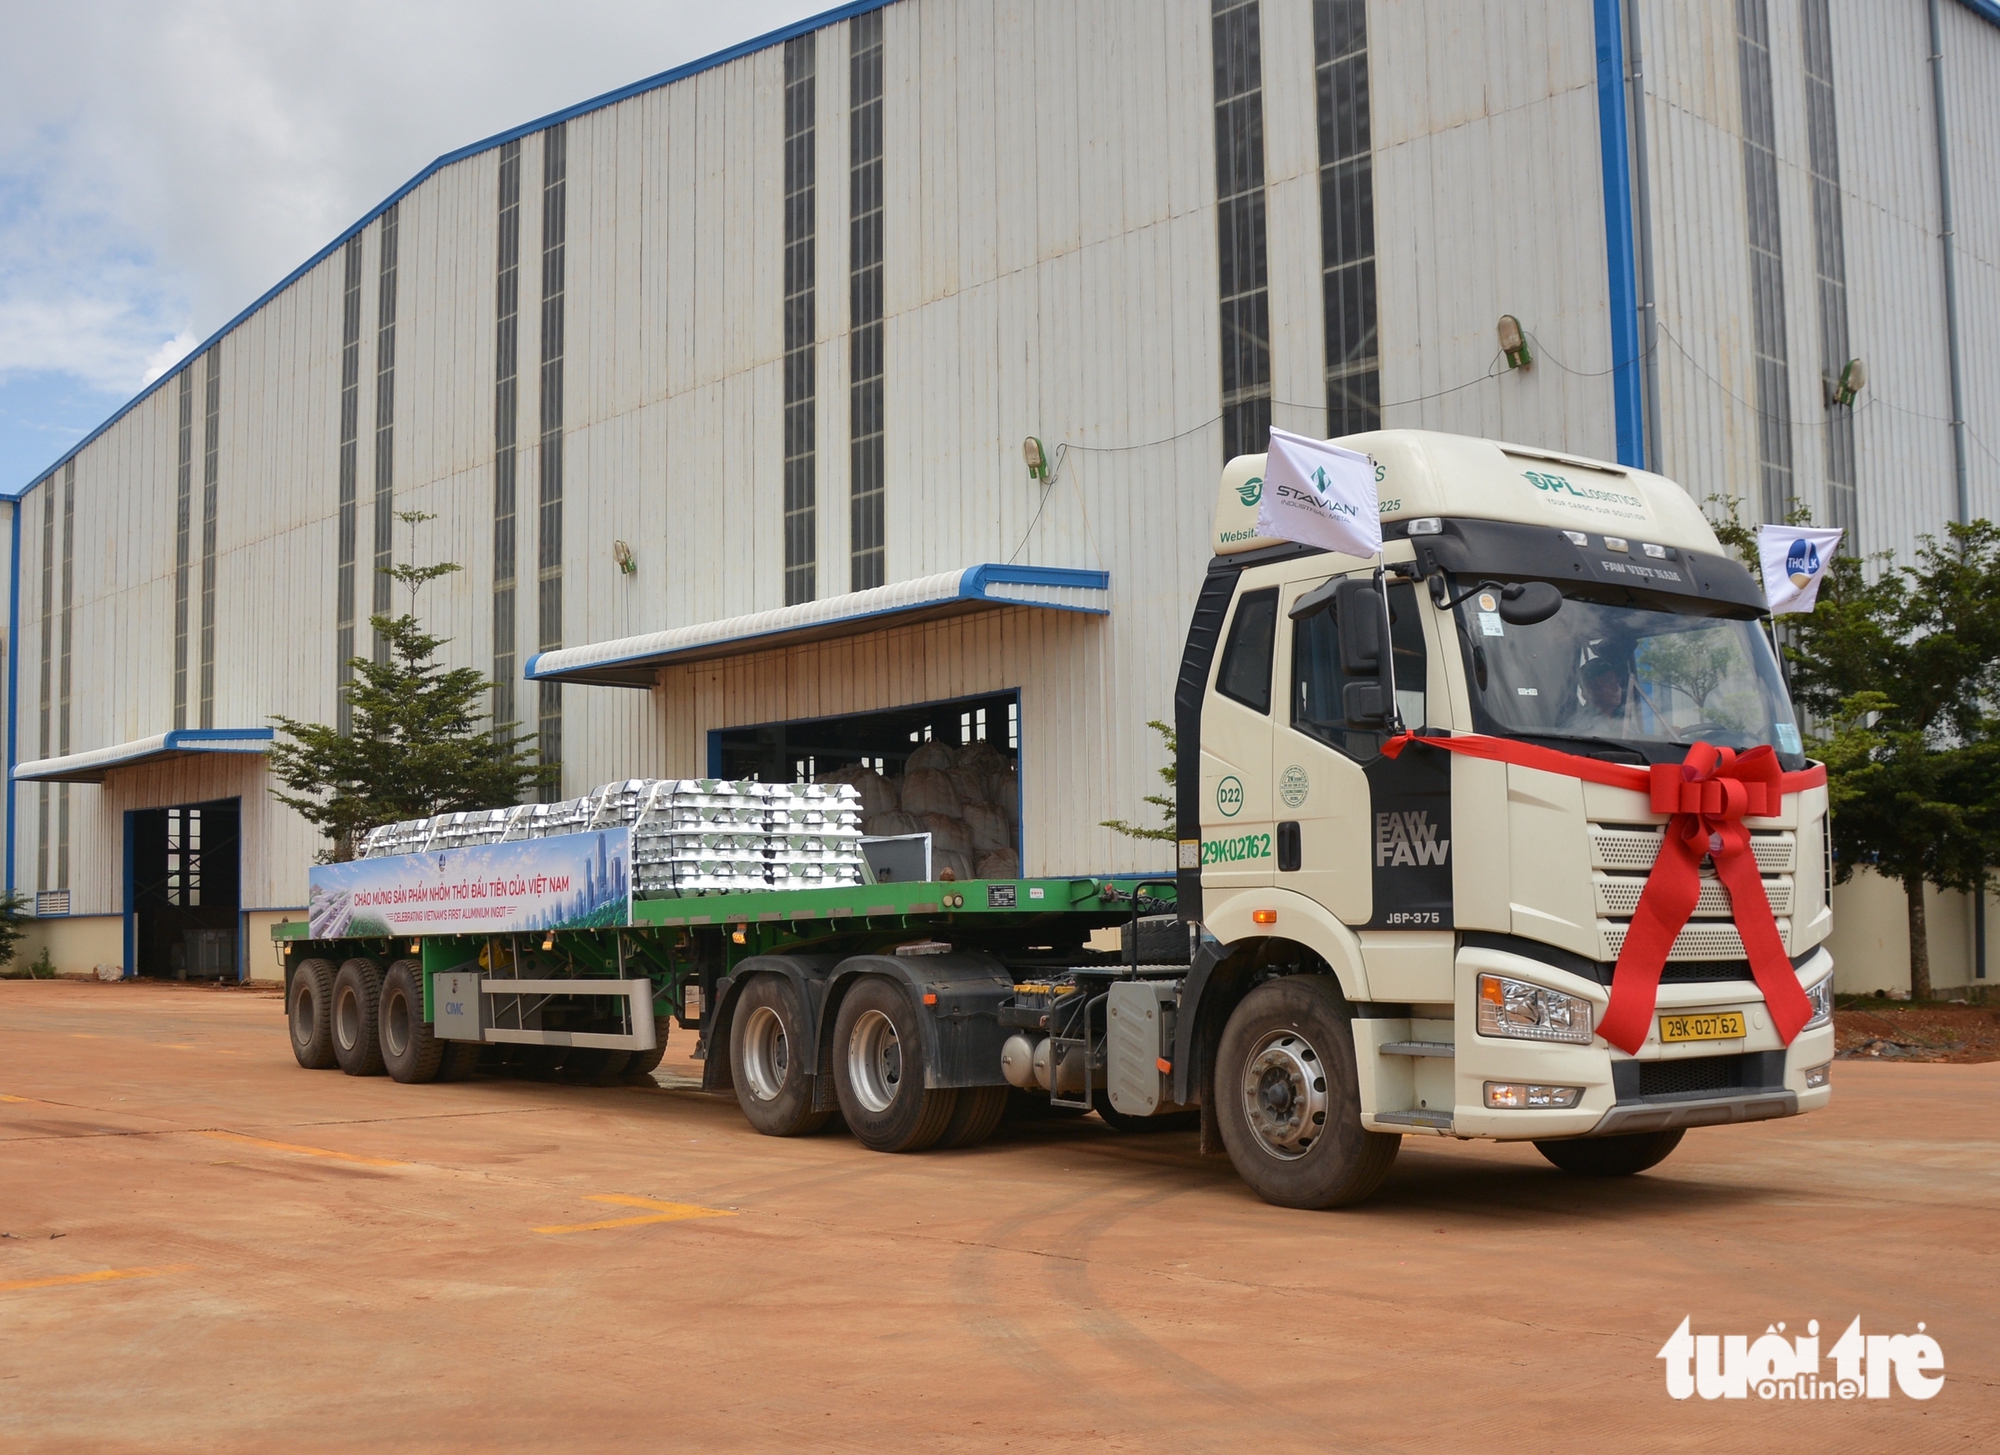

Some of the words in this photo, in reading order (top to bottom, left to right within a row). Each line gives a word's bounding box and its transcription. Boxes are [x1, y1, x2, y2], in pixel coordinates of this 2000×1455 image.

[1276, 485, 1356, 517] STAVIAN
[1581, 487, 1642, 507] LOGISTICS
[1281, 499, 1327, 518] INDUSTRIAL
[1328, 513, 1352, 524] METAL
[1601, 561, 1626, 573] FAW
[1625, 564, 1655, 578] VIET
[1653, 569, 1682, 582] NAM
[1220, 788, 1241, 803] D22
[1376, 840, 1450, 867] FAW
[354, 888, 372, 907] CHÀO
[372, 886, 392, 905] MỪNG
[393, 884, 408, 904] SẢN
[408, 880, 428, 903] PHẨM
[429, 882, 451, 901] NHÔM
[452, 878, 469, 899] THỎI
[471, 875, 488, 898] ĐẦU
[489, 876, 507, 897] TIÊN
[509, 874, 527, 896] CỦA
[528, 872, 547, 898] VIỆT
[549, 875, 570, 893] NAM
[393, 910, 424, 923] CELEBRATING
[448, 908, 462, 919] FIRST
[462, 906, 490, 919] ALUMINIUM
[490, 906, 507, 918] INGOT
[1386, 912, 1440, 925] J6P-375
[445, 1002, 464, 1016] CIMC
